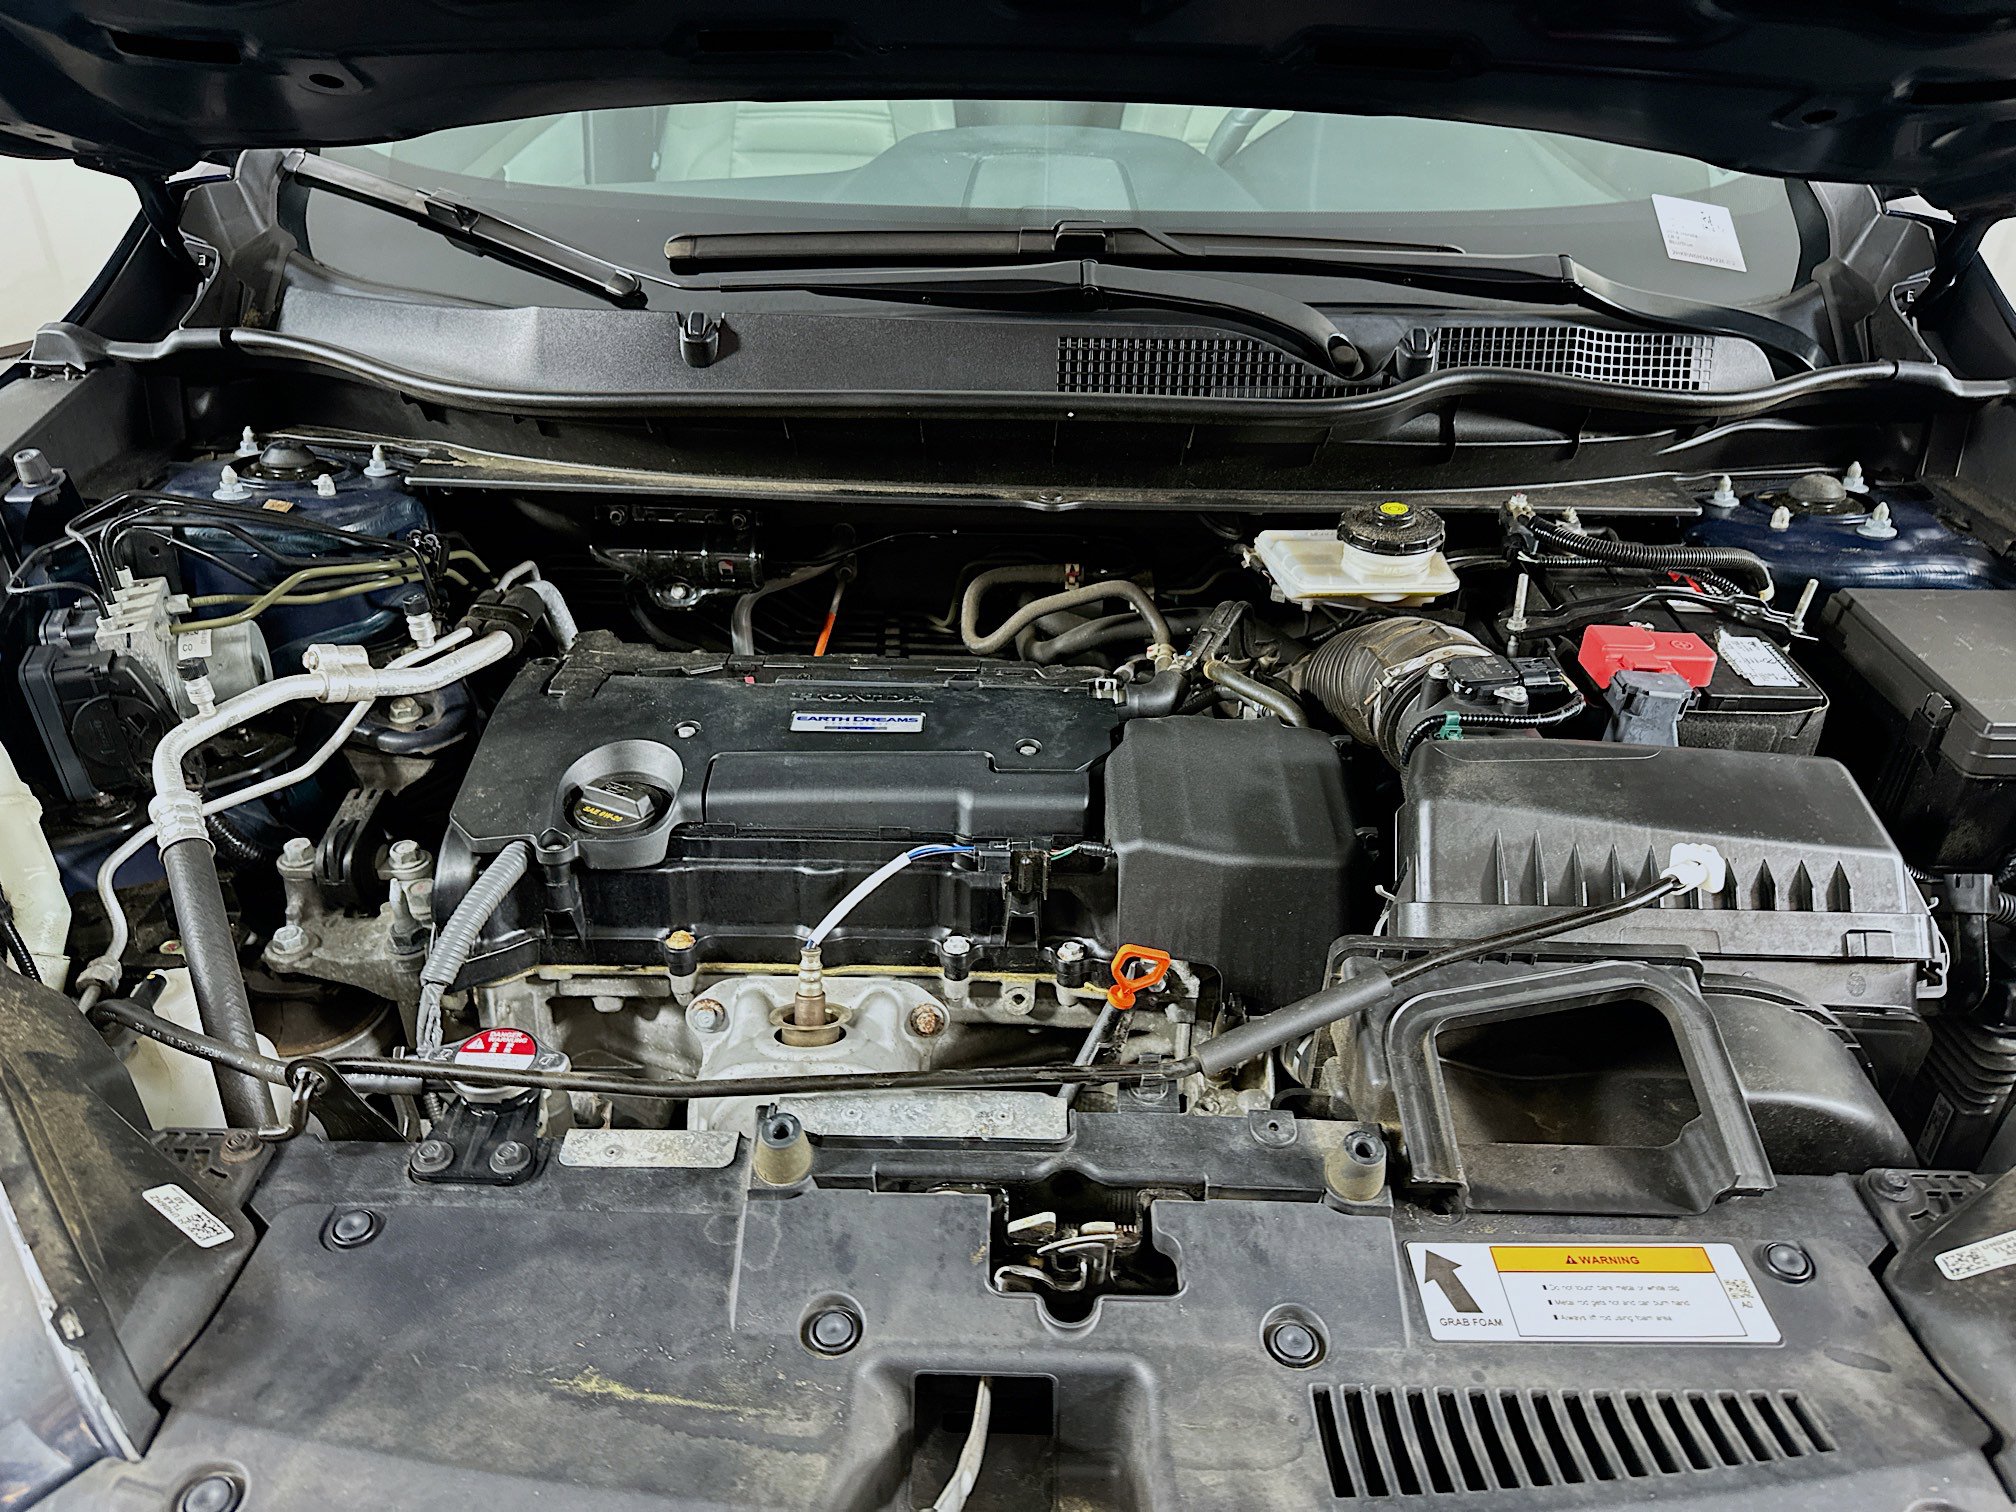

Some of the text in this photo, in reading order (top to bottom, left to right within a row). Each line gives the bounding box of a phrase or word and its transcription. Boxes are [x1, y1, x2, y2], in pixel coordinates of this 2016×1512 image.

[1578, 1255, 1640, 1265] WARNING
[1439, 1317, 1504, 1327] GRAB FOAM
